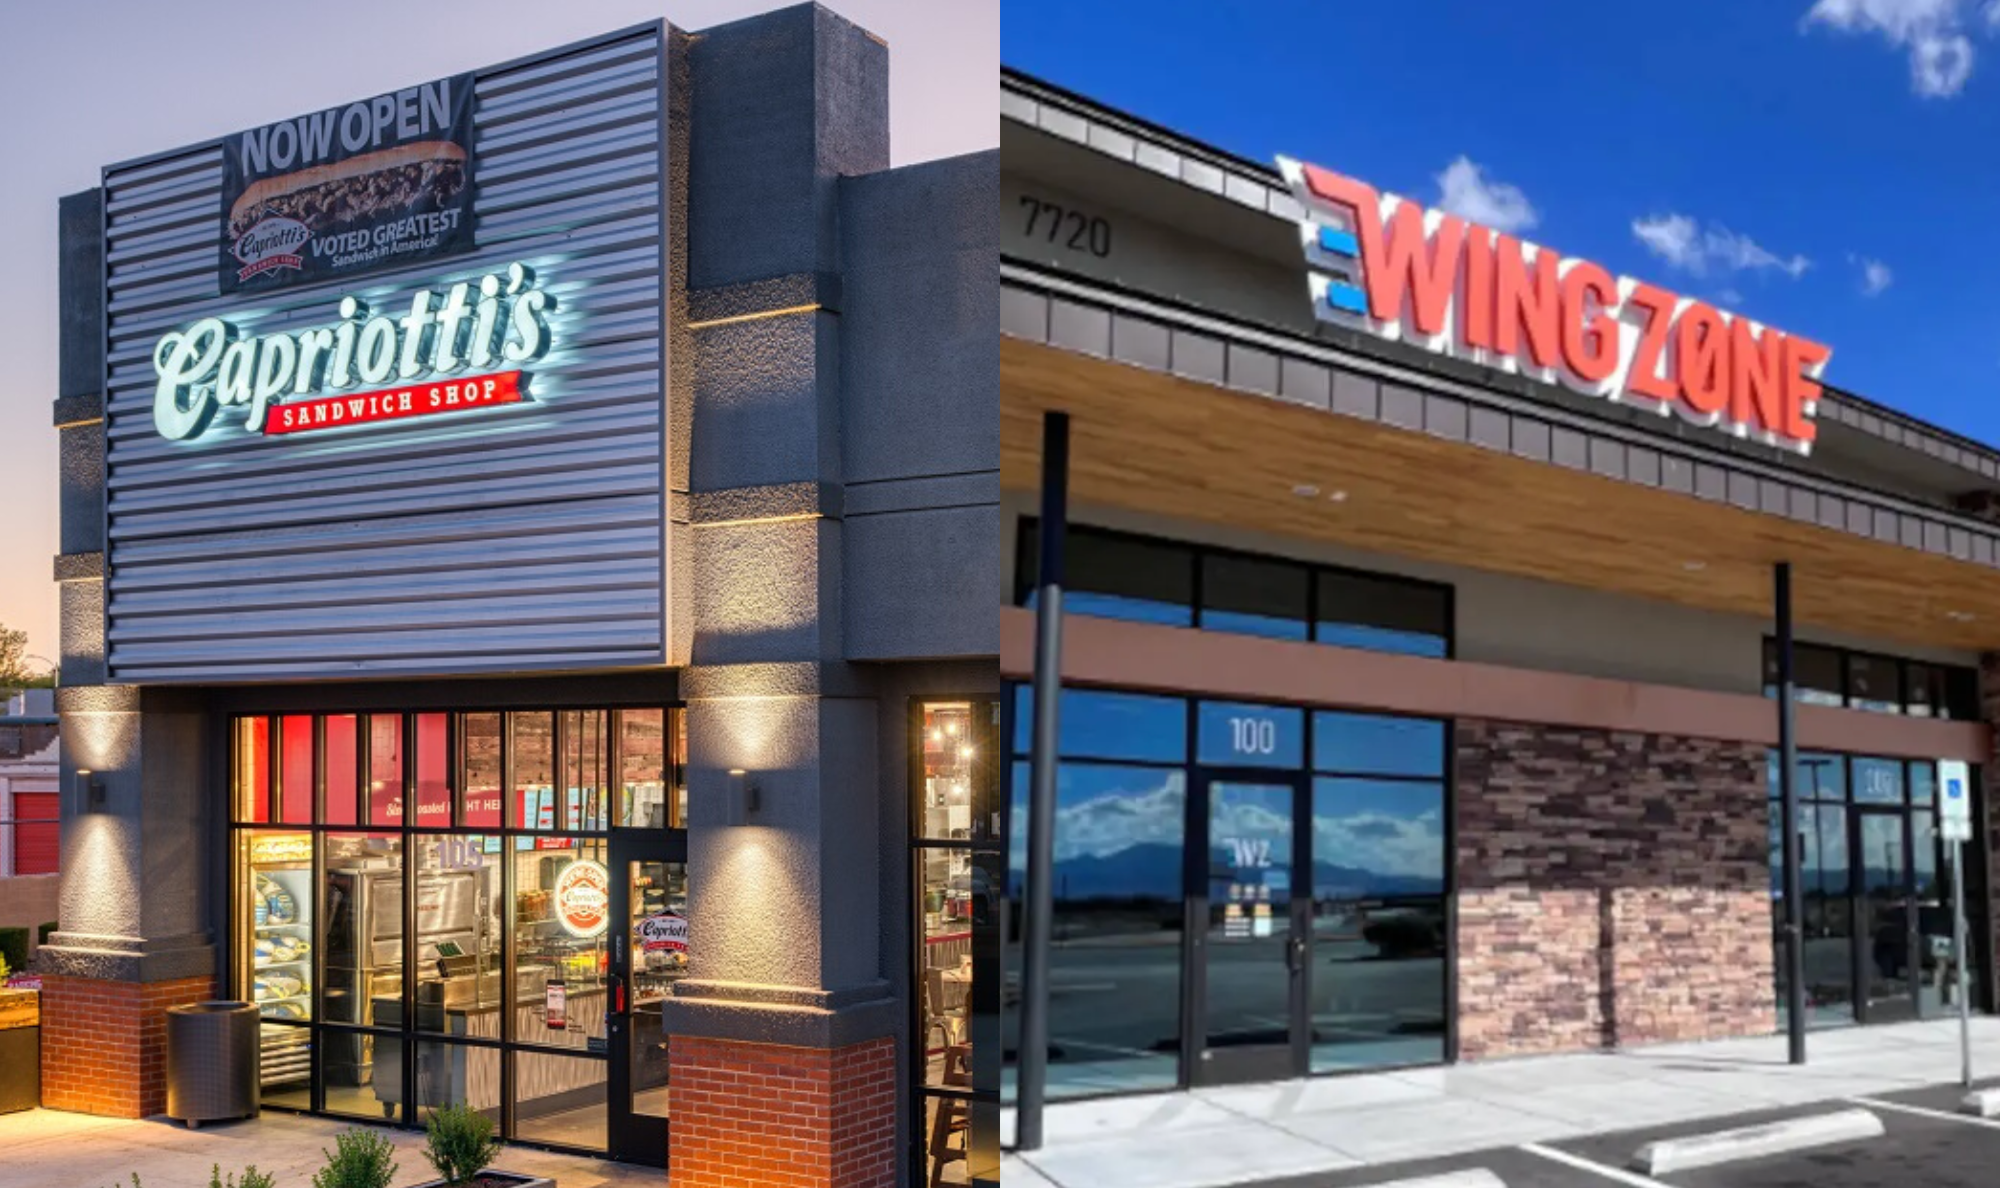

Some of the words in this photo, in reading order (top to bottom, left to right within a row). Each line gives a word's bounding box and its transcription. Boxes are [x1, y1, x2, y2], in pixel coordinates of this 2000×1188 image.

[241, 110, 339, 177] NOW
[340, 79, 451, 152] OPEN
[312, 229, 370, 257] VOTED
[373, 208, 461, 245] GREATEST
[1019, 195, 1112, 258] 7720
[1302, 162, 1620, 383] WING
[153, 261, 555, 440] Capriotti's
[283, 392, 412, 427] SANDWICH
[430, 380, 497, 406] SHOP
[1229, 717, 1275, 754] 100
[435, 838, 483, 871] 105
